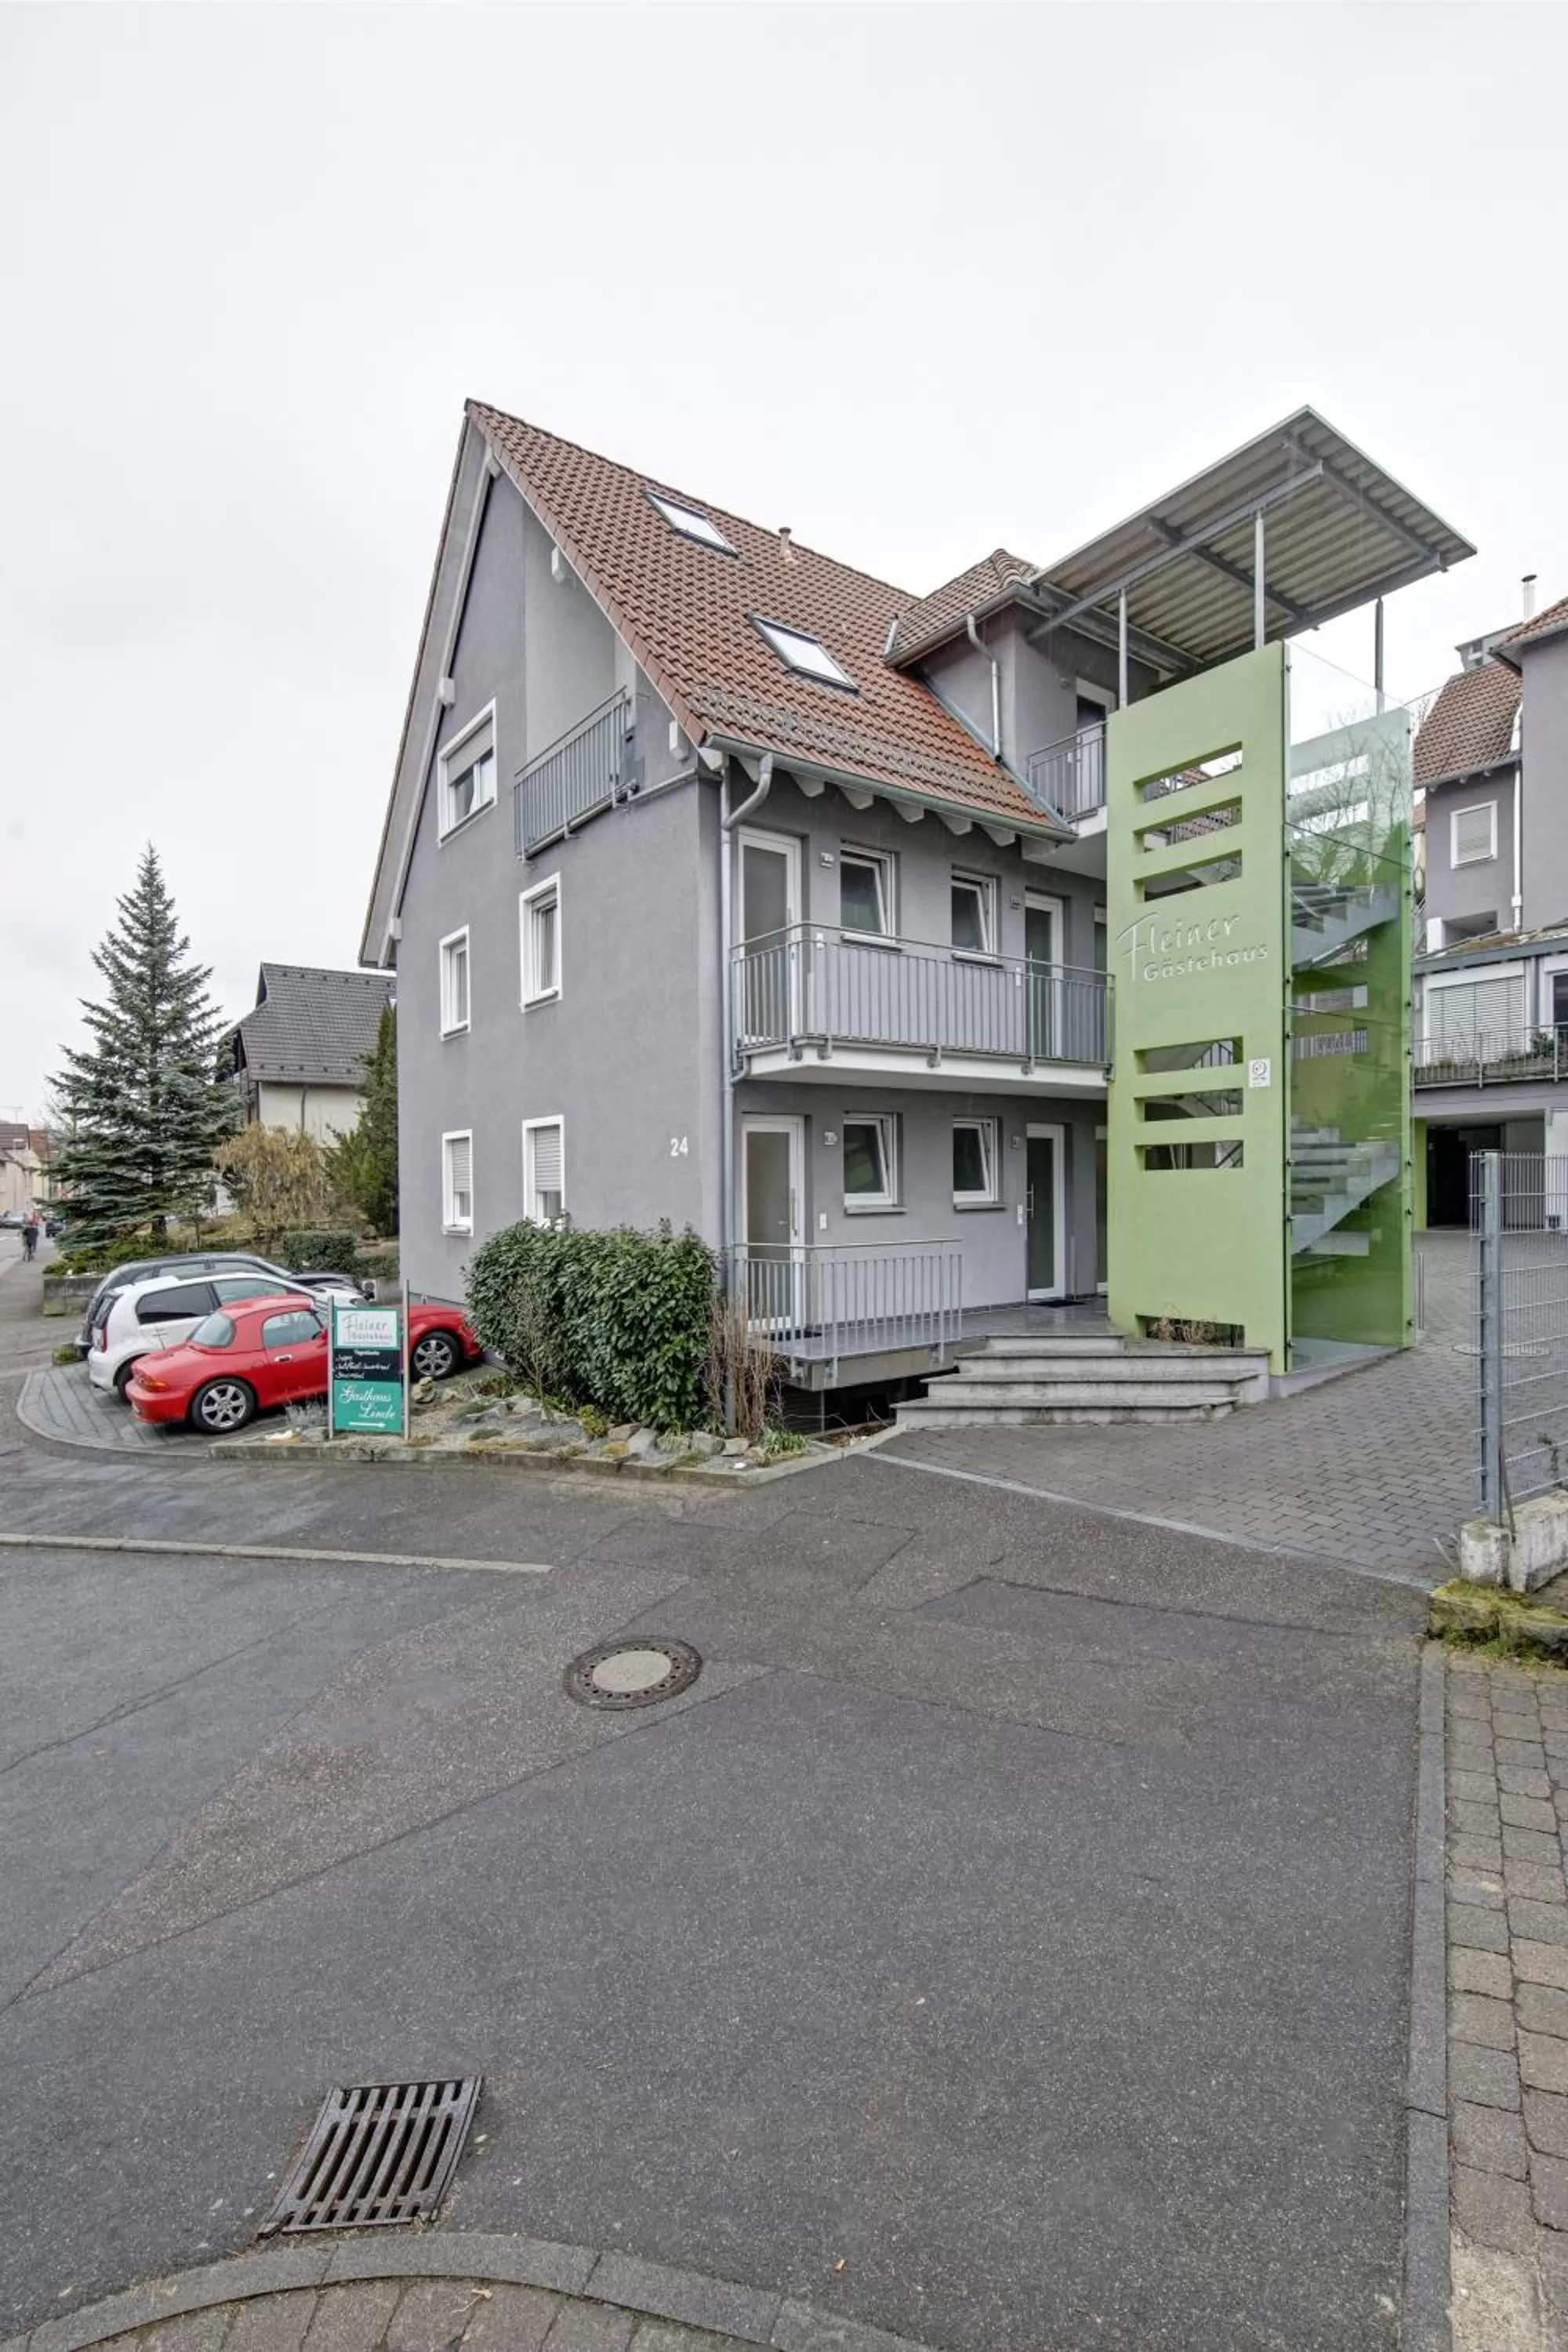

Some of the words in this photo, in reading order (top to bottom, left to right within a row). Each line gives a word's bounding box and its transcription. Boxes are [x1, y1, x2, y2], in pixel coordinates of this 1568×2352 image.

[1116, 912, 1240, 980] Fleiner
[1144, 944, 1268, 981] Gästehaus
[670, 1136, 689, 1157] 24
[342, 1313, 387, 1340] Fleiner
[339, 1385, 391, 1403] Gasthaus
[359, 1402, 395, 1418] Linde
